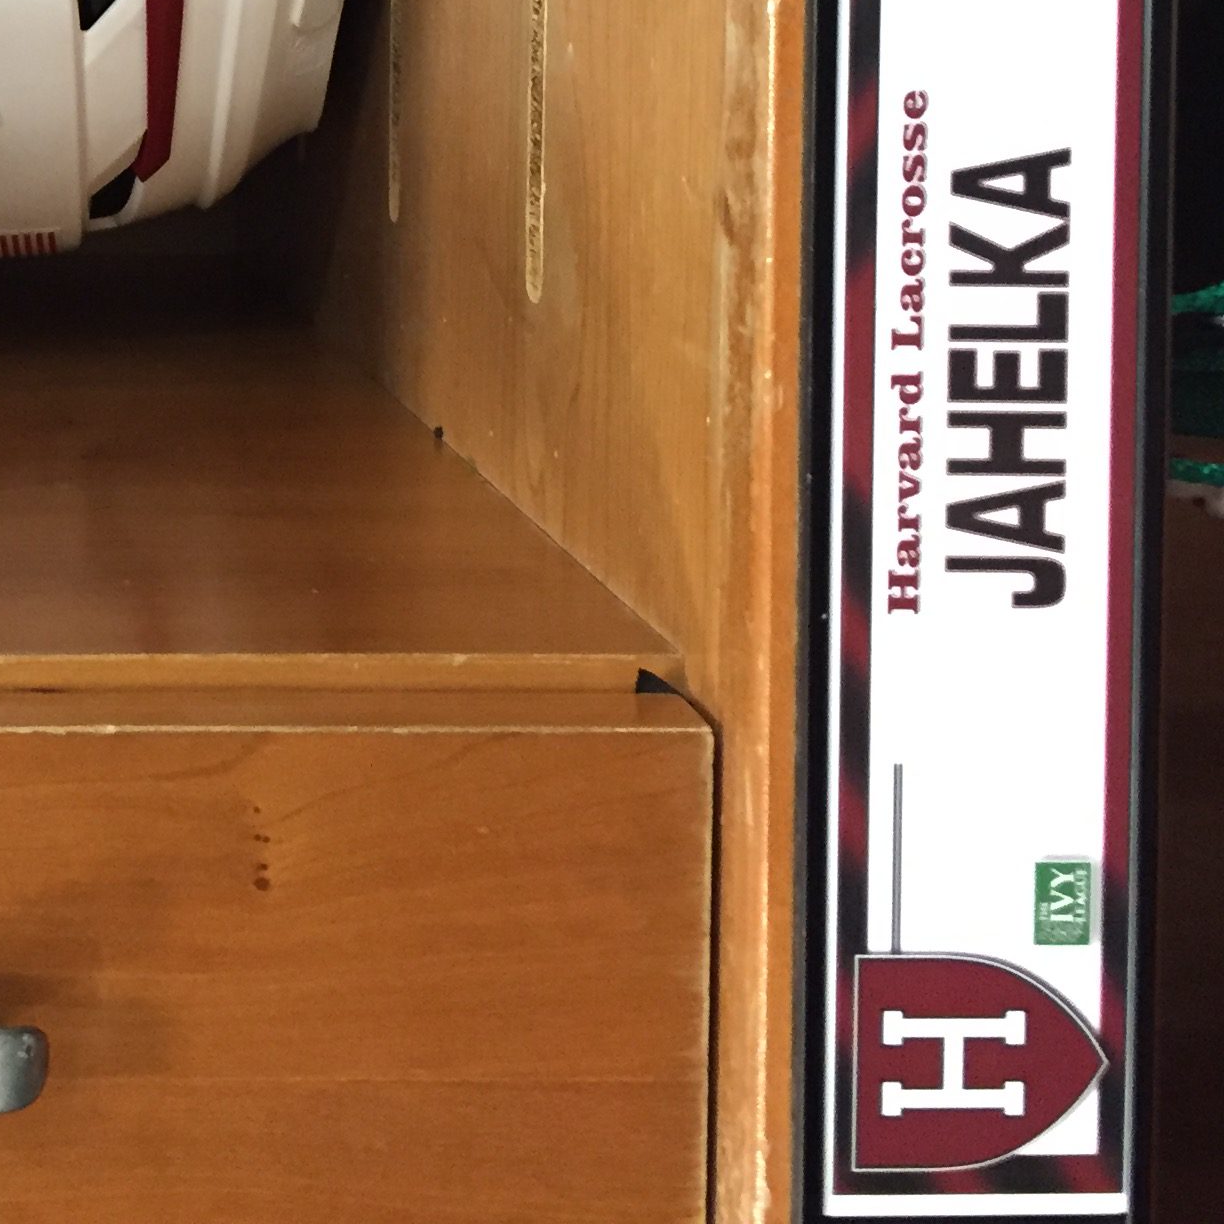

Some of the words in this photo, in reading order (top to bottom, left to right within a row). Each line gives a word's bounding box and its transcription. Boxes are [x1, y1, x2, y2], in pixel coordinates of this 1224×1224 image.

[890, 89, 930, 351] Lacrosse
[887, 371, 924, 615] Harvard
[944, 146, 1073, 609] JAHELKA
[1049, 868, 1074, 923] IVY
[881, 1010, 1026, 1116] H
